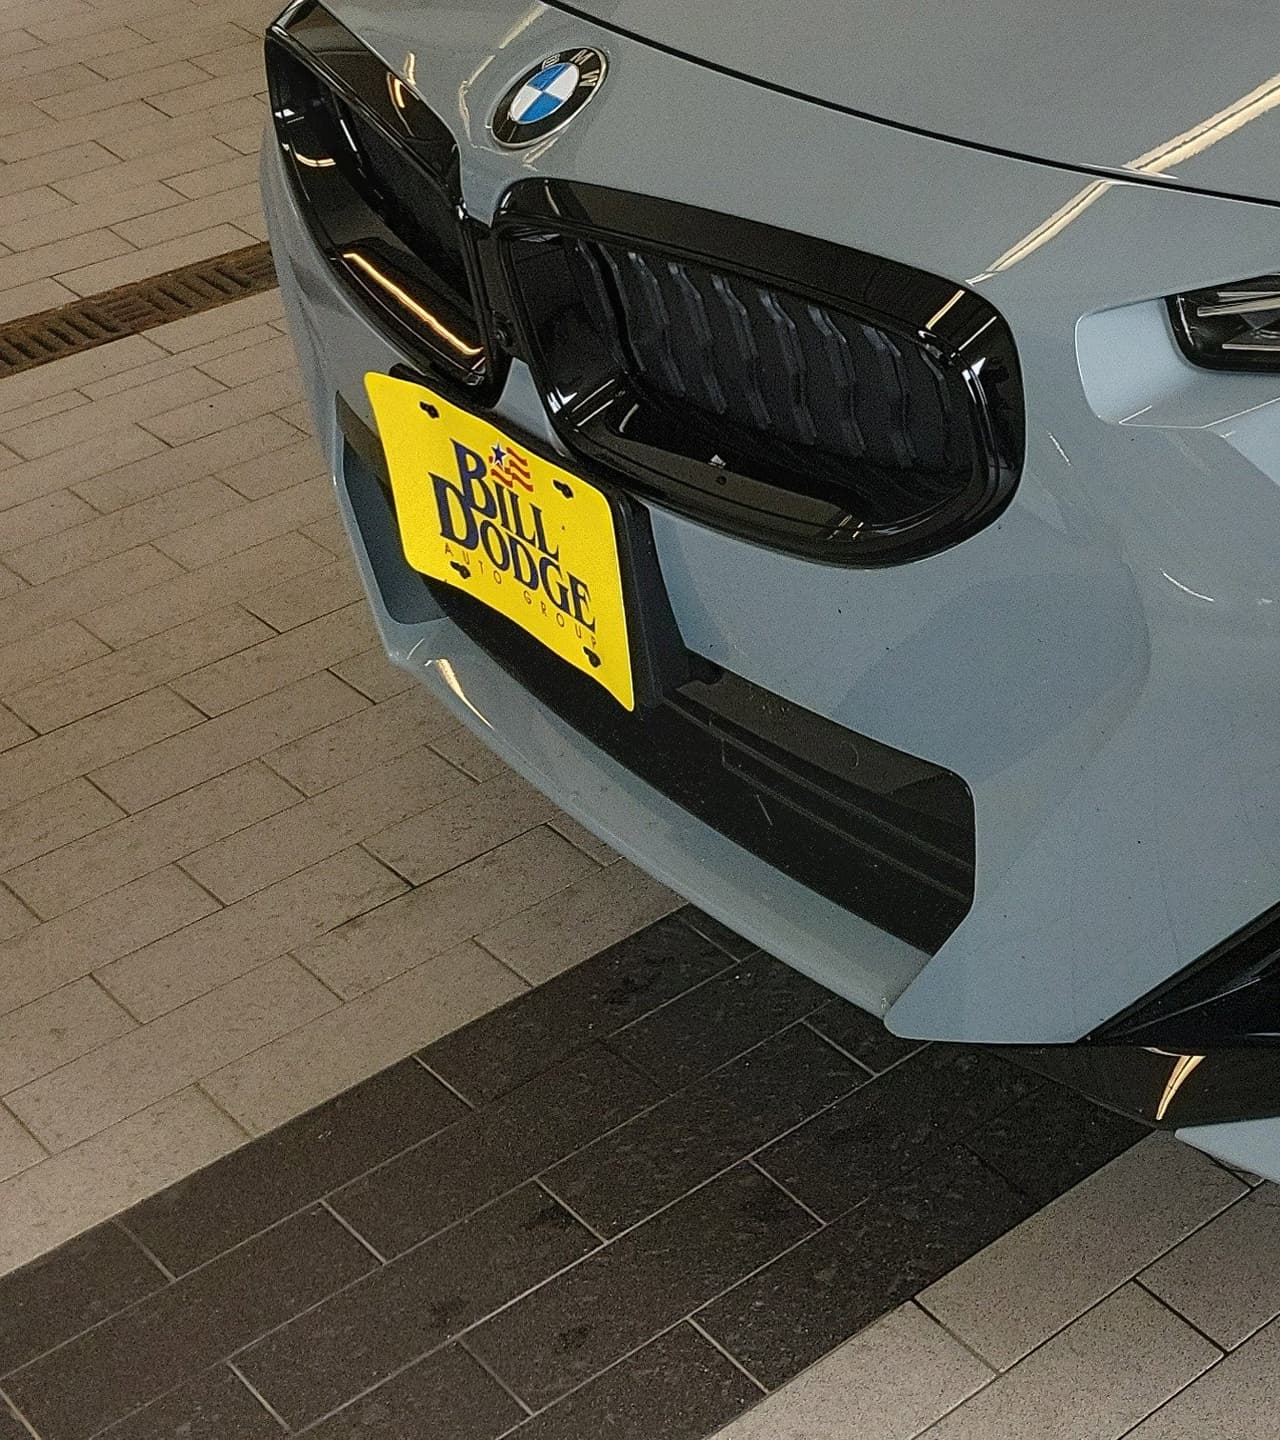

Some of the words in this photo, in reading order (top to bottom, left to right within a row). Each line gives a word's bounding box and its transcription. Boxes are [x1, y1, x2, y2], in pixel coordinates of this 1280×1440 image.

[428, 472, 597, 634] DODGE
[450, 438, 560, 564] BILL
[444, 543, 502, 585] AUTO
[523, 590, 597, 648] GROUP
